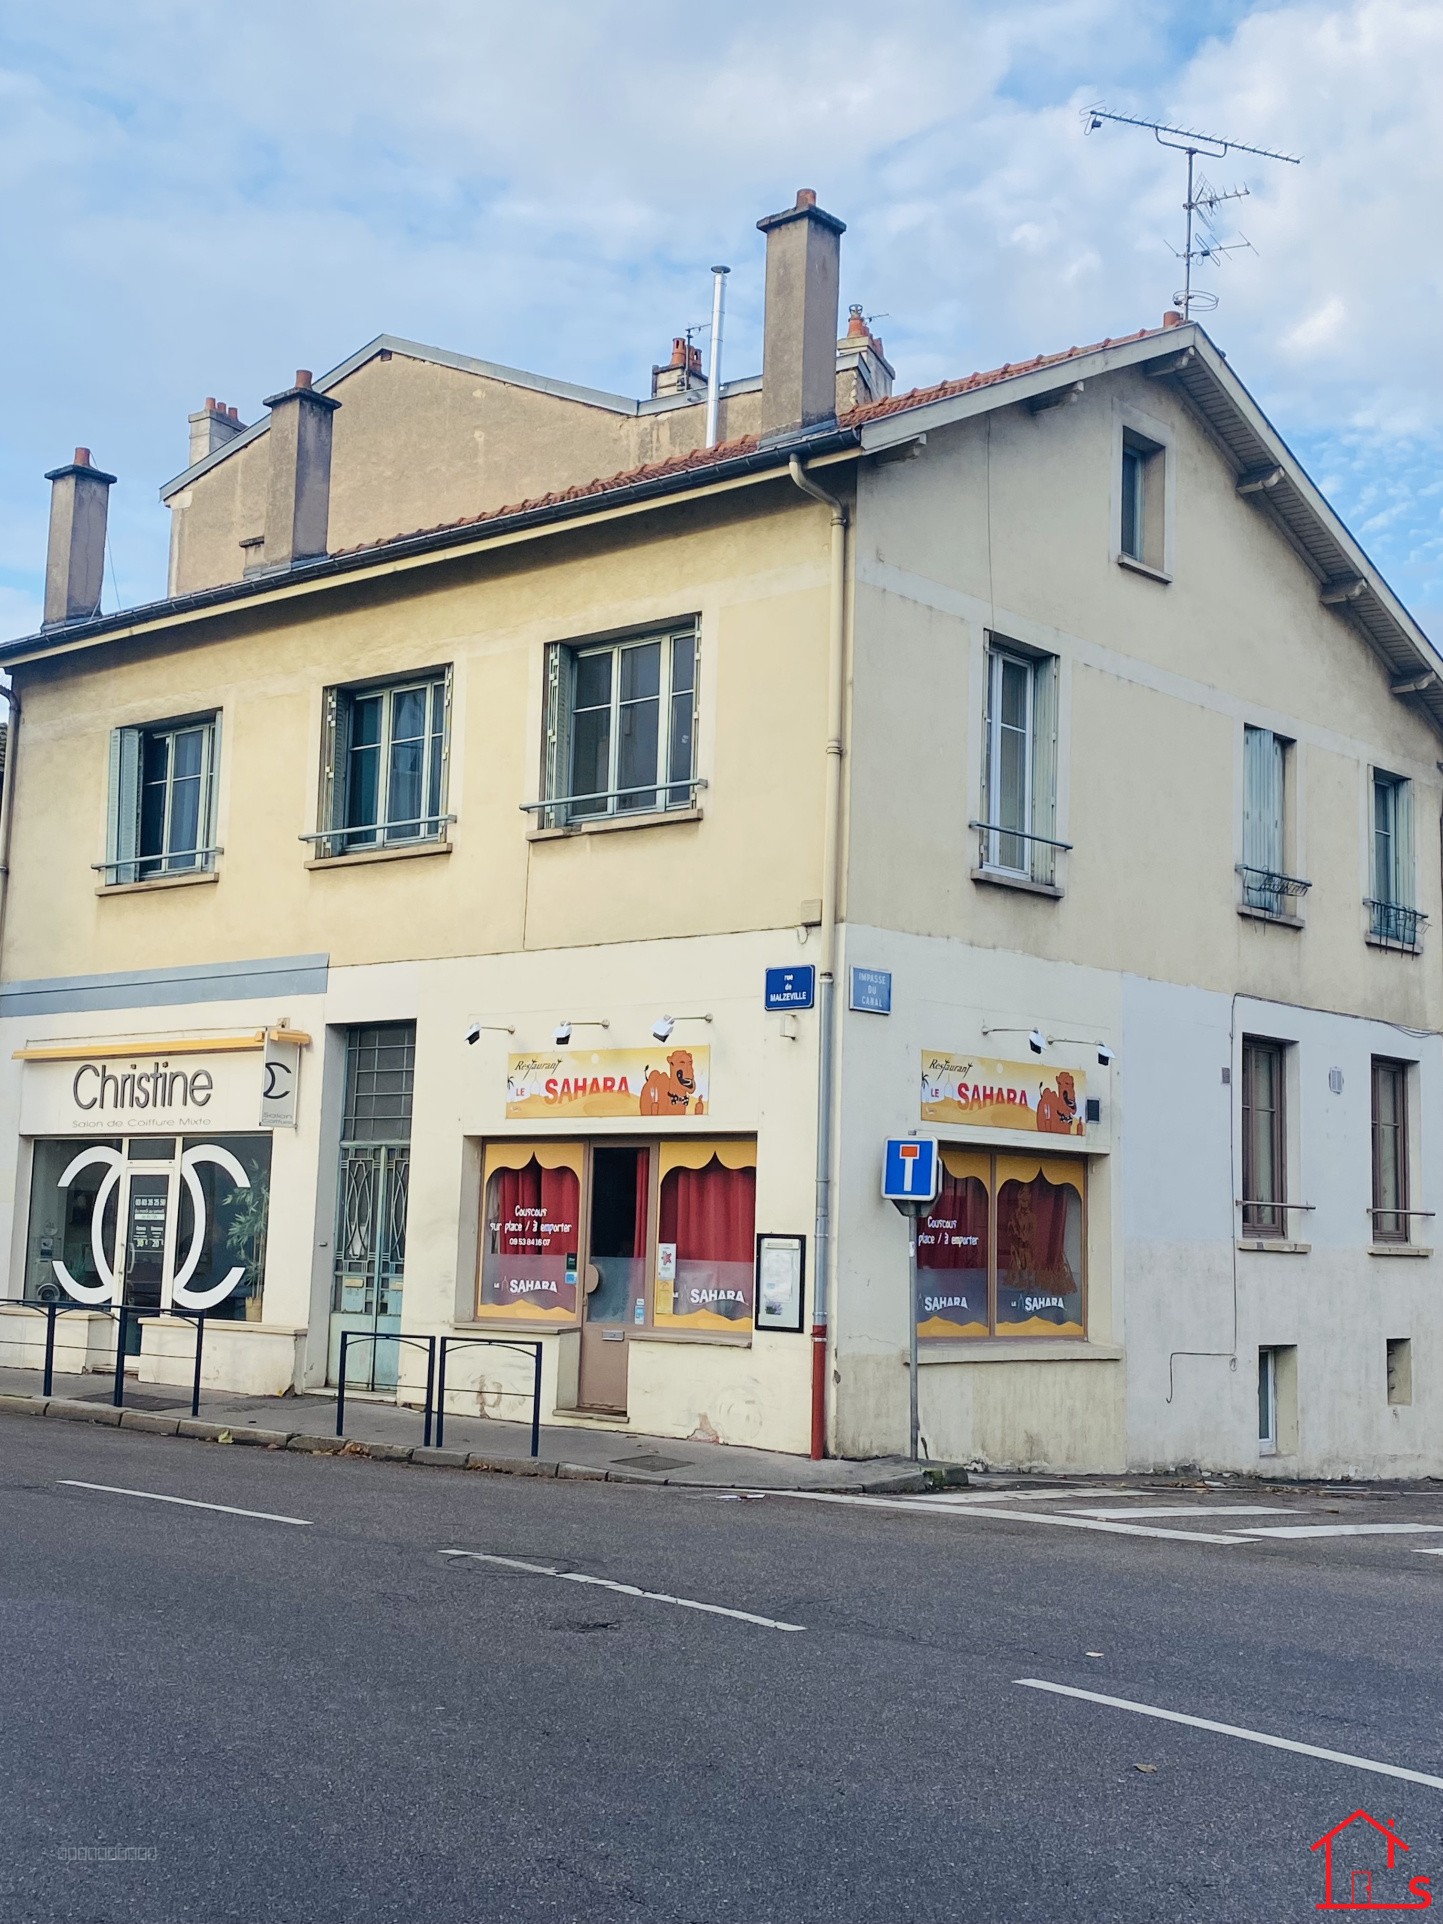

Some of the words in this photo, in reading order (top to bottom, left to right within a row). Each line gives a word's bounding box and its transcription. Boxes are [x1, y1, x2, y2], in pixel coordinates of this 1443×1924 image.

[858, 972, 886, 985] IMPASSE
[770, 991, 807, 1002] MALZEVILLE
[867, 985, 877, 995] DU
[861, 996, 883, 1008] CANAL
[514, 1058, 563, 1081] Restaurant
[929, 1059, 973, 1082] Restaurant
[73, 1061, 213, 1109] Christine
[516, 1087, 525, 1097] LE
[544, 1076, 631, 1105] SAHARA
[930, 1088, 940, 1098] LE
[957, 1082, 1029, 1111] SAHARA
[263, 1111, 293, 1119] Salon
[72, 1119, 104, 1128] Salon
[106, 1119, 123, 1128] de
[126, 1118, 175, 1127] Coiffure
[179, 1118, 211, 1126] Mixte
[515, 1205, 547, 1217] Couscous
[490, 1222, 502, 1231] sur
[504, 1220, 523, 1234] place
[532, 1220, 538, 1232] à
[540, 1223, 572, 1235] emporter
[927, 1216, 958, 1229] Couscous
[918, 1233, 935, 1247] place
[944, 1233, 949, 1245] à
[951, 1236, 979, 1248] emporter
[509, 1279, 558, 1293] SAHARA
[690, 1288, 745, 1304] SAHARA
[924, 1296, 969, 1312] SAHARA
[1025, 1296, 1066, 1312] SAHARA
